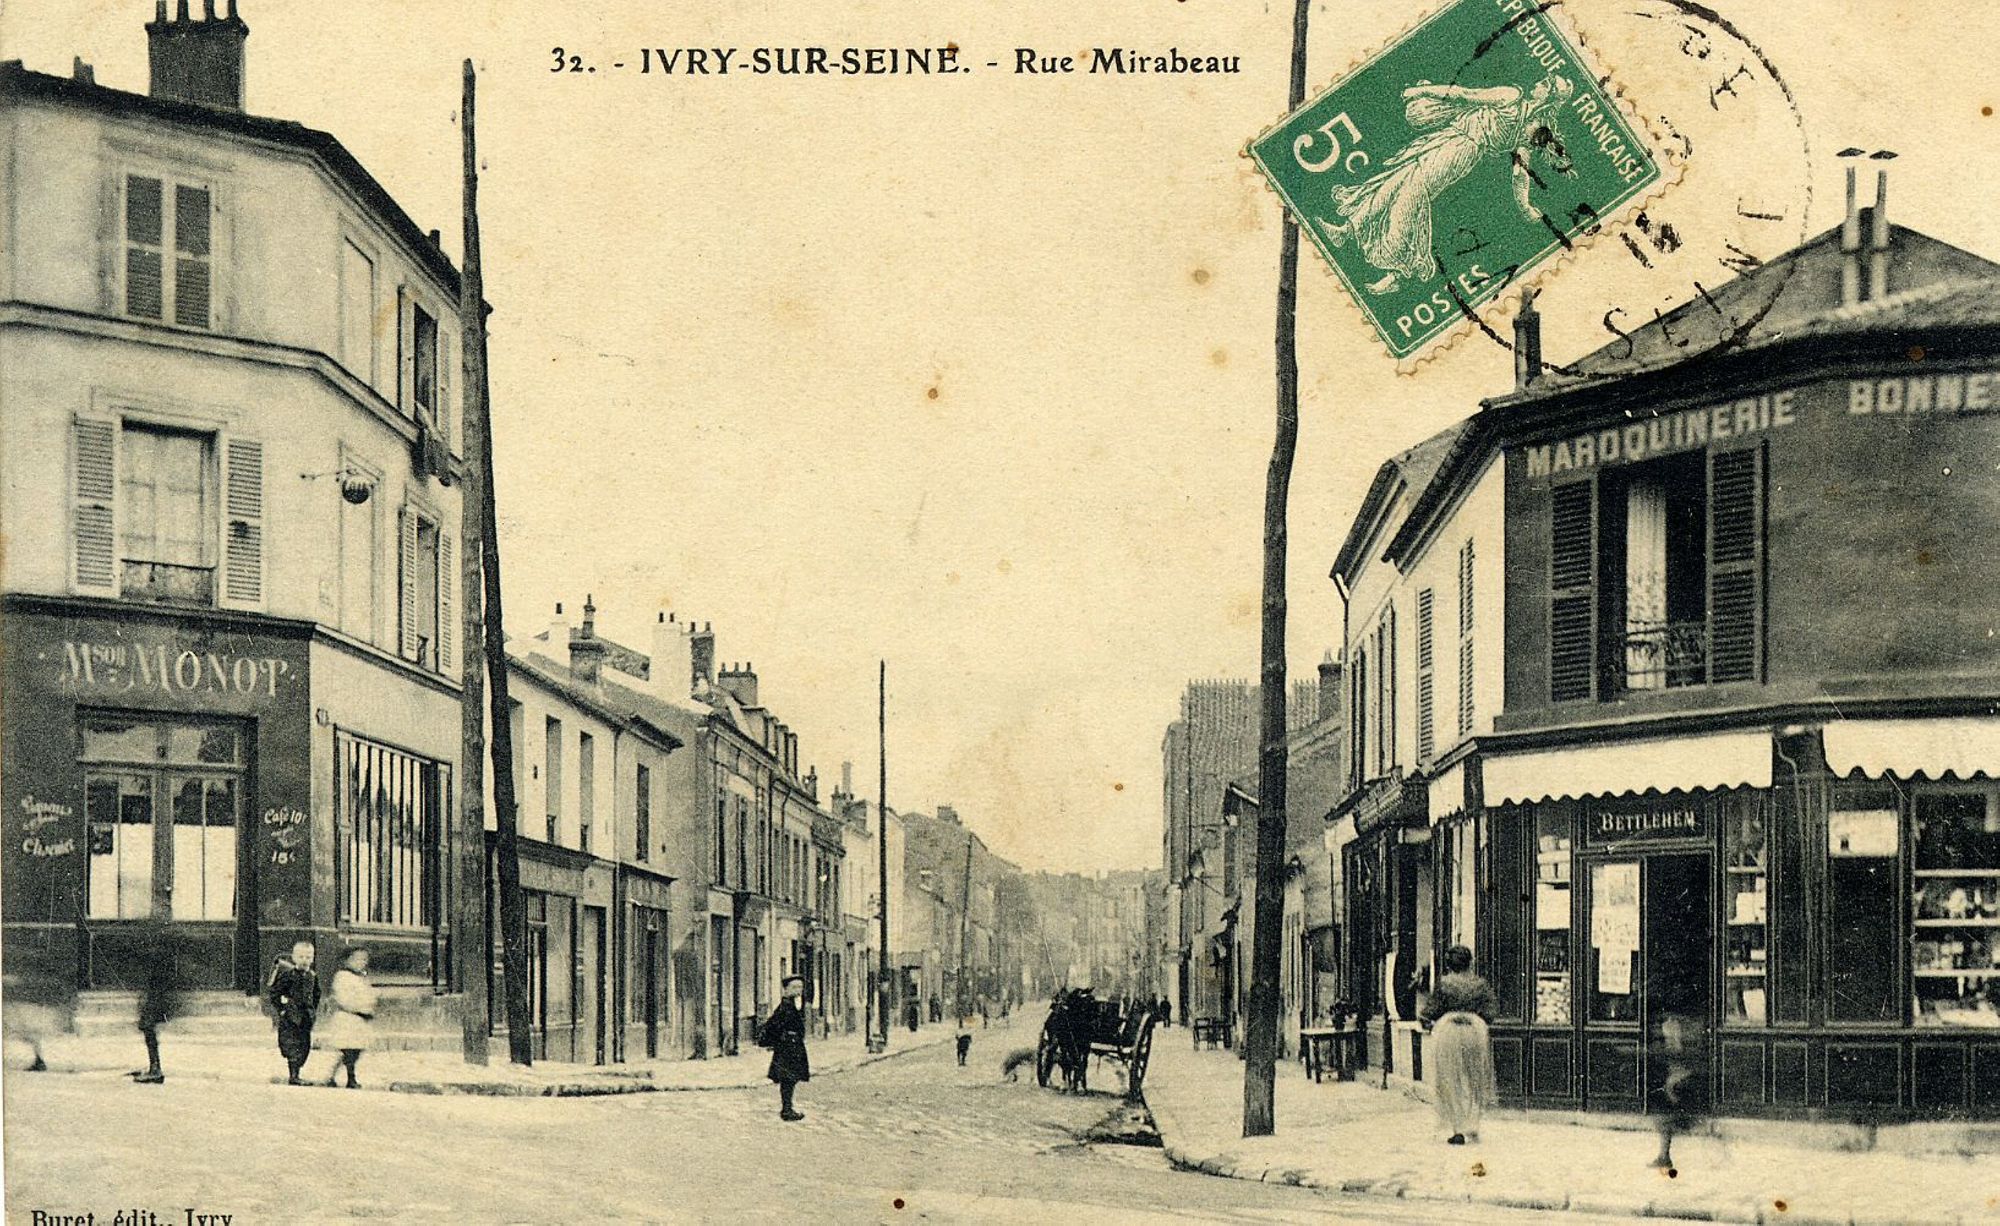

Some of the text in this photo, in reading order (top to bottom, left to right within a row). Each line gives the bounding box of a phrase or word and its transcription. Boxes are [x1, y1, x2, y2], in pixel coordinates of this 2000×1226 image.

[1572, 93, 1644, 183] FRANÇAISE
[1849, 373, 2000, 414] BONNE
[1526, 390, 1798, 478] MAROQUINERIE
[123, 643, 288, 698] MONOT
